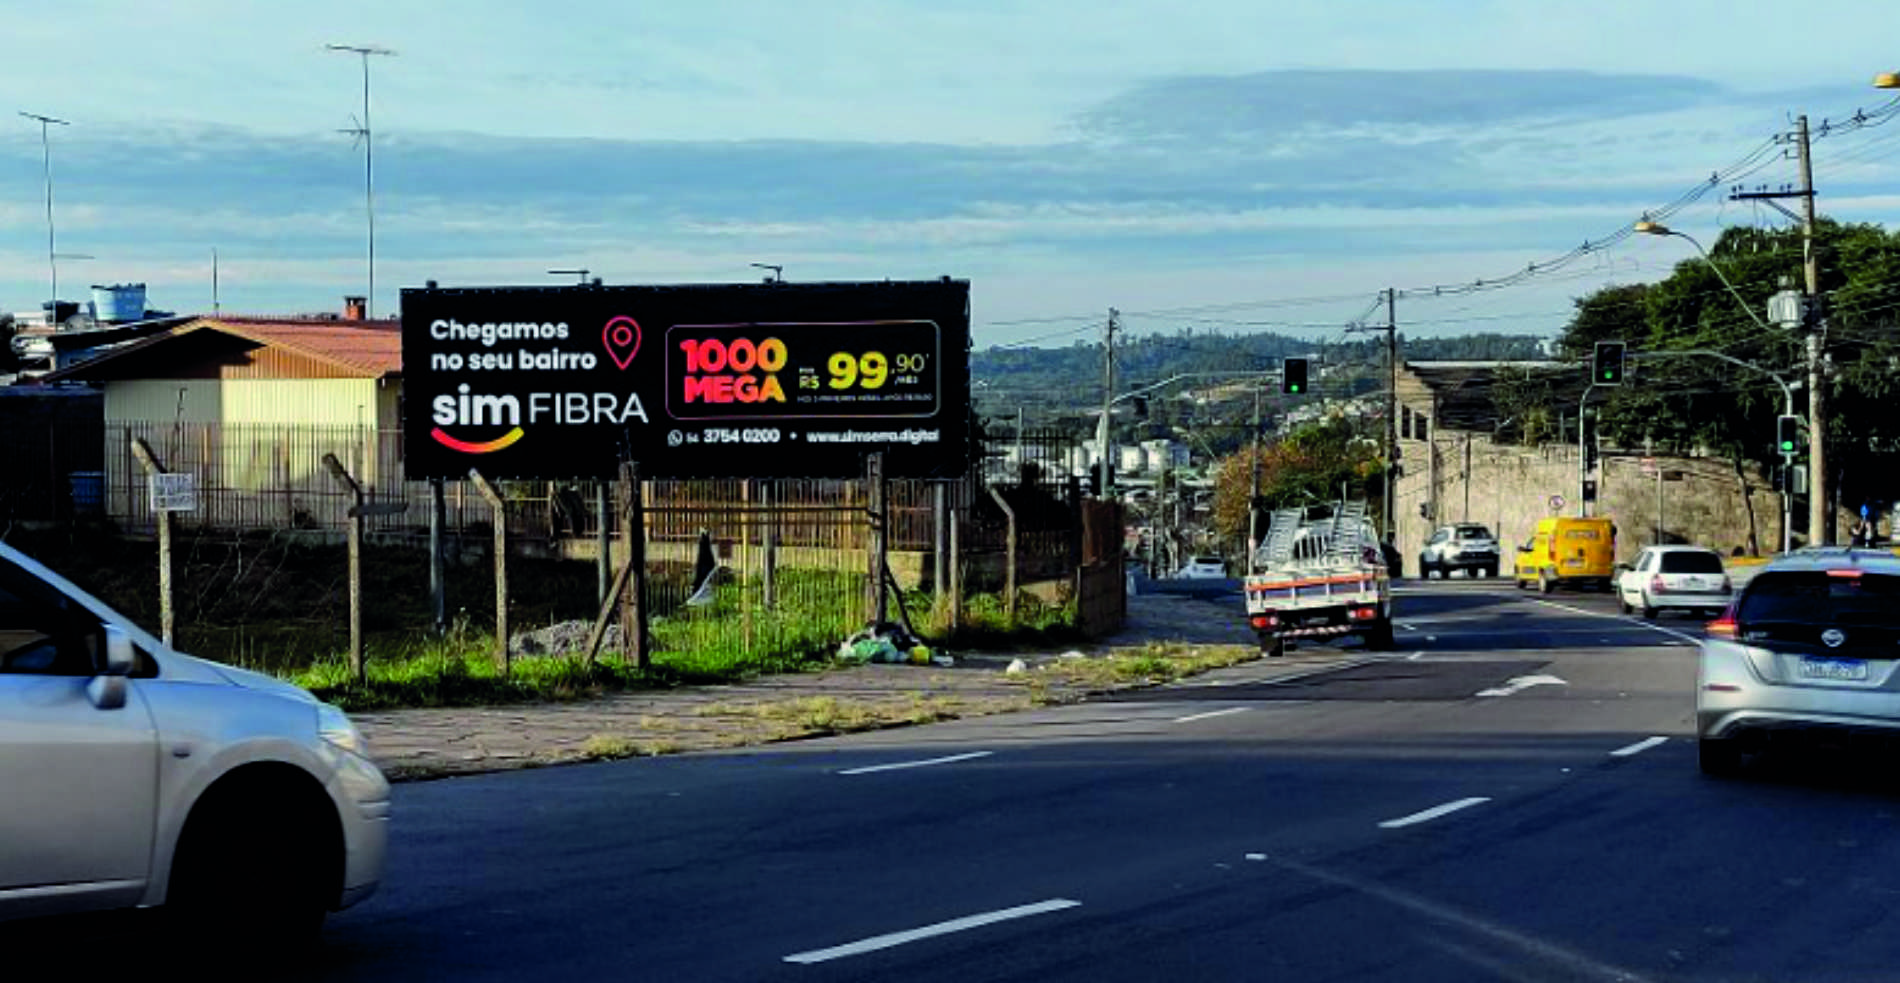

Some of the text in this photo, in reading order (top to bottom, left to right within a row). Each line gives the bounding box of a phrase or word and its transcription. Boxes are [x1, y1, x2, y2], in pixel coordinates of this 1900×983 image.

[430, 319, 569, 346] Chegamos
[431, 348, 597, 370] no seu bairro
[680, 337, 788, 373] 1000
[684, 374, 787, 403] MEGA
[432, 383, 649, 426] sim FIBRA
[703, 428, 740, 443] 3754
[743, 428, 781, 443] 0200
